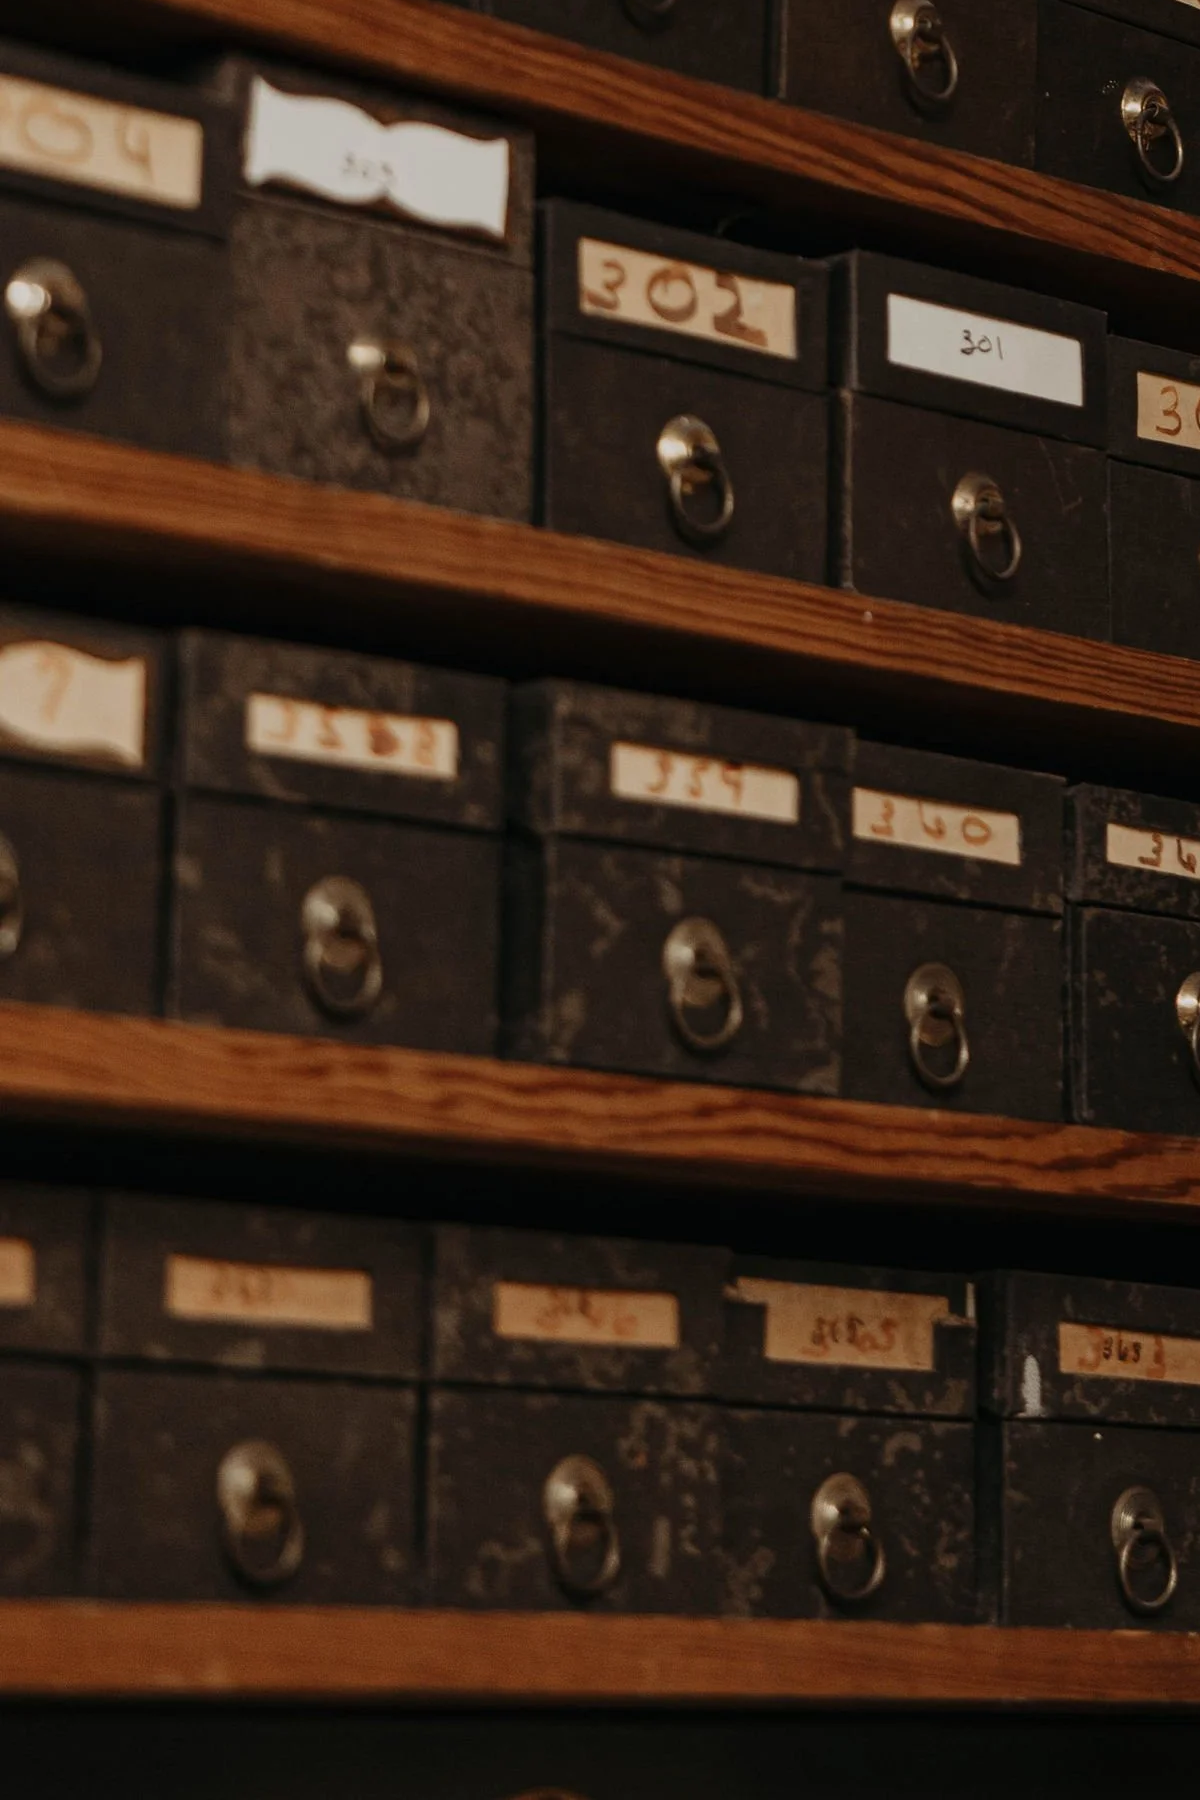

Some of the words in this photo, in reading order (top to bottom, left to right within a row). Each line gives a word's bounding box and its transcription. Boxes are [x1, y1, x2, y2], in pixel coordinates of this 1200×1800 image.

[583, 258, 768, 347] 302
[959, 328, 1003, 361] 301
[870, 798, 992, 845] 360
